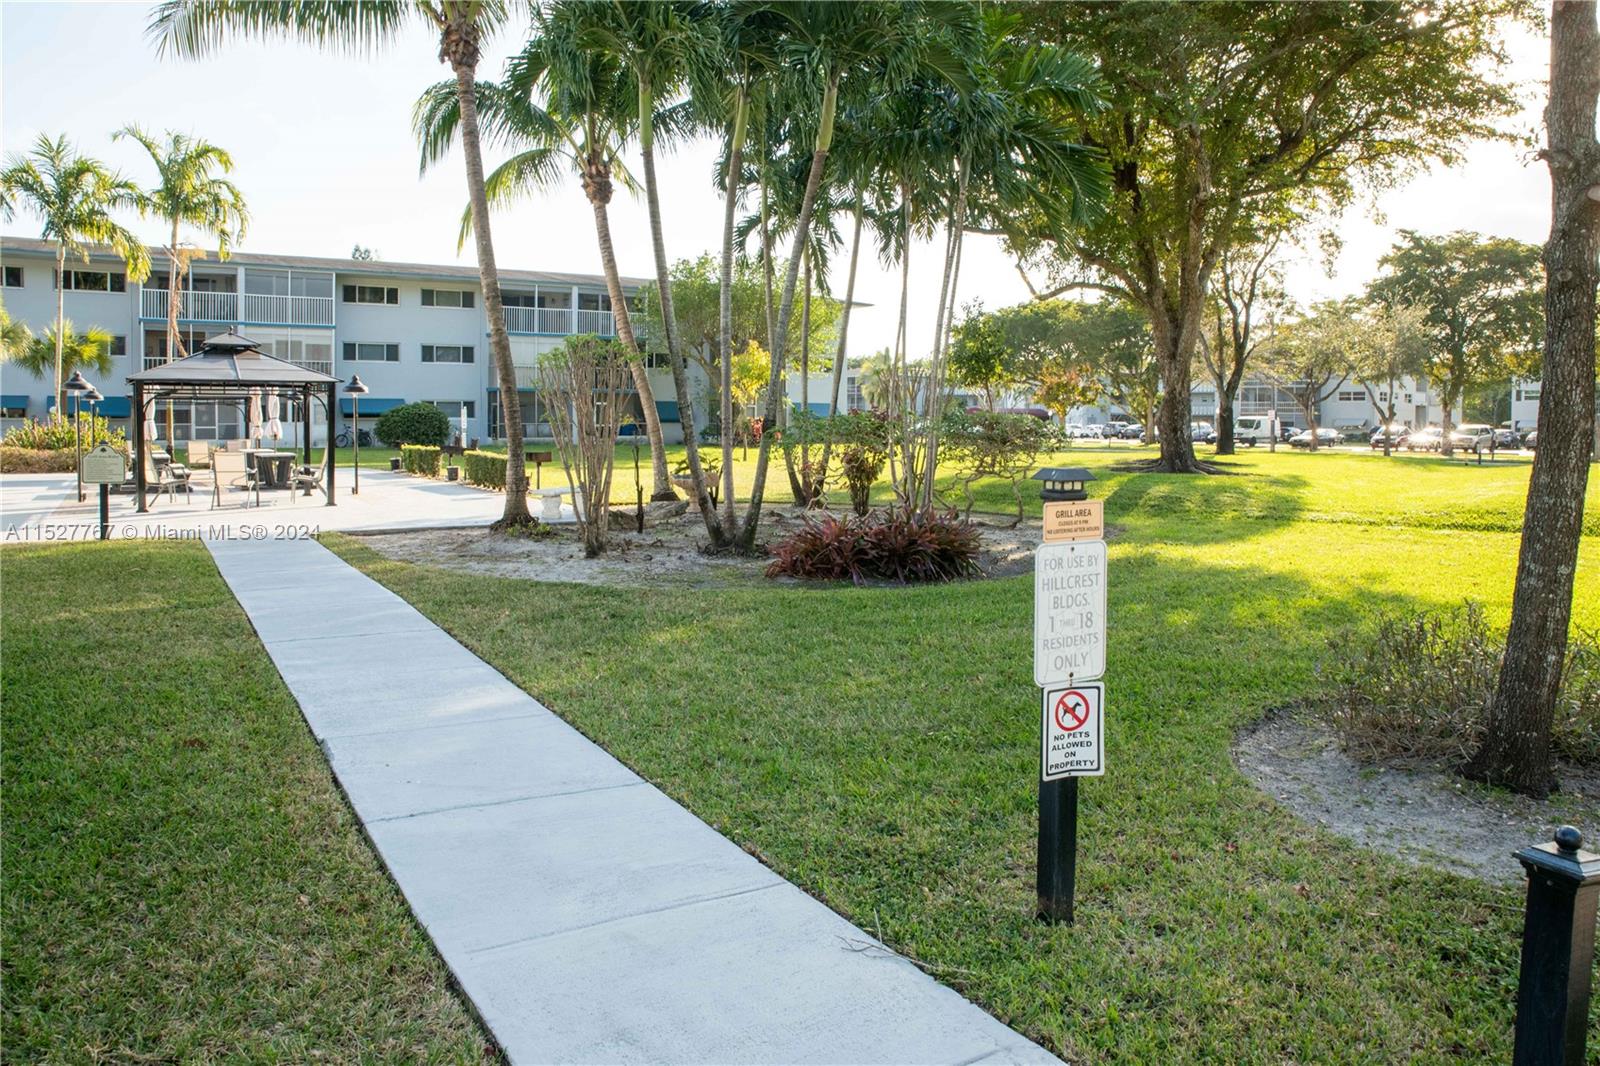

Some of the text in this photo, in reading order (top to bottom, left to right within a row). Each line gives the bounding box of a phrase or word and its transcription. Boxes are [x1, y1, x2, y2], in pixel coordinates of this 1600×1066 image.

[1056, 509, 1091, 518] GRILL AREA
[1044, 555, 1099, 570] FOR USE BY
[1042, 573, 1100, 591] HILLCREST
[1049, 612, 1093, 632] 1 THRU 18
[1043, 632, 1098, 650] RESIDENTS
[1055, 653, 1088, 670] ONLY
[1068, 731, 1090, 739] PETS
[1052, 741, 1092, 751] ALLOWED
[1049, 760, 1094, 771] PROPERTY
